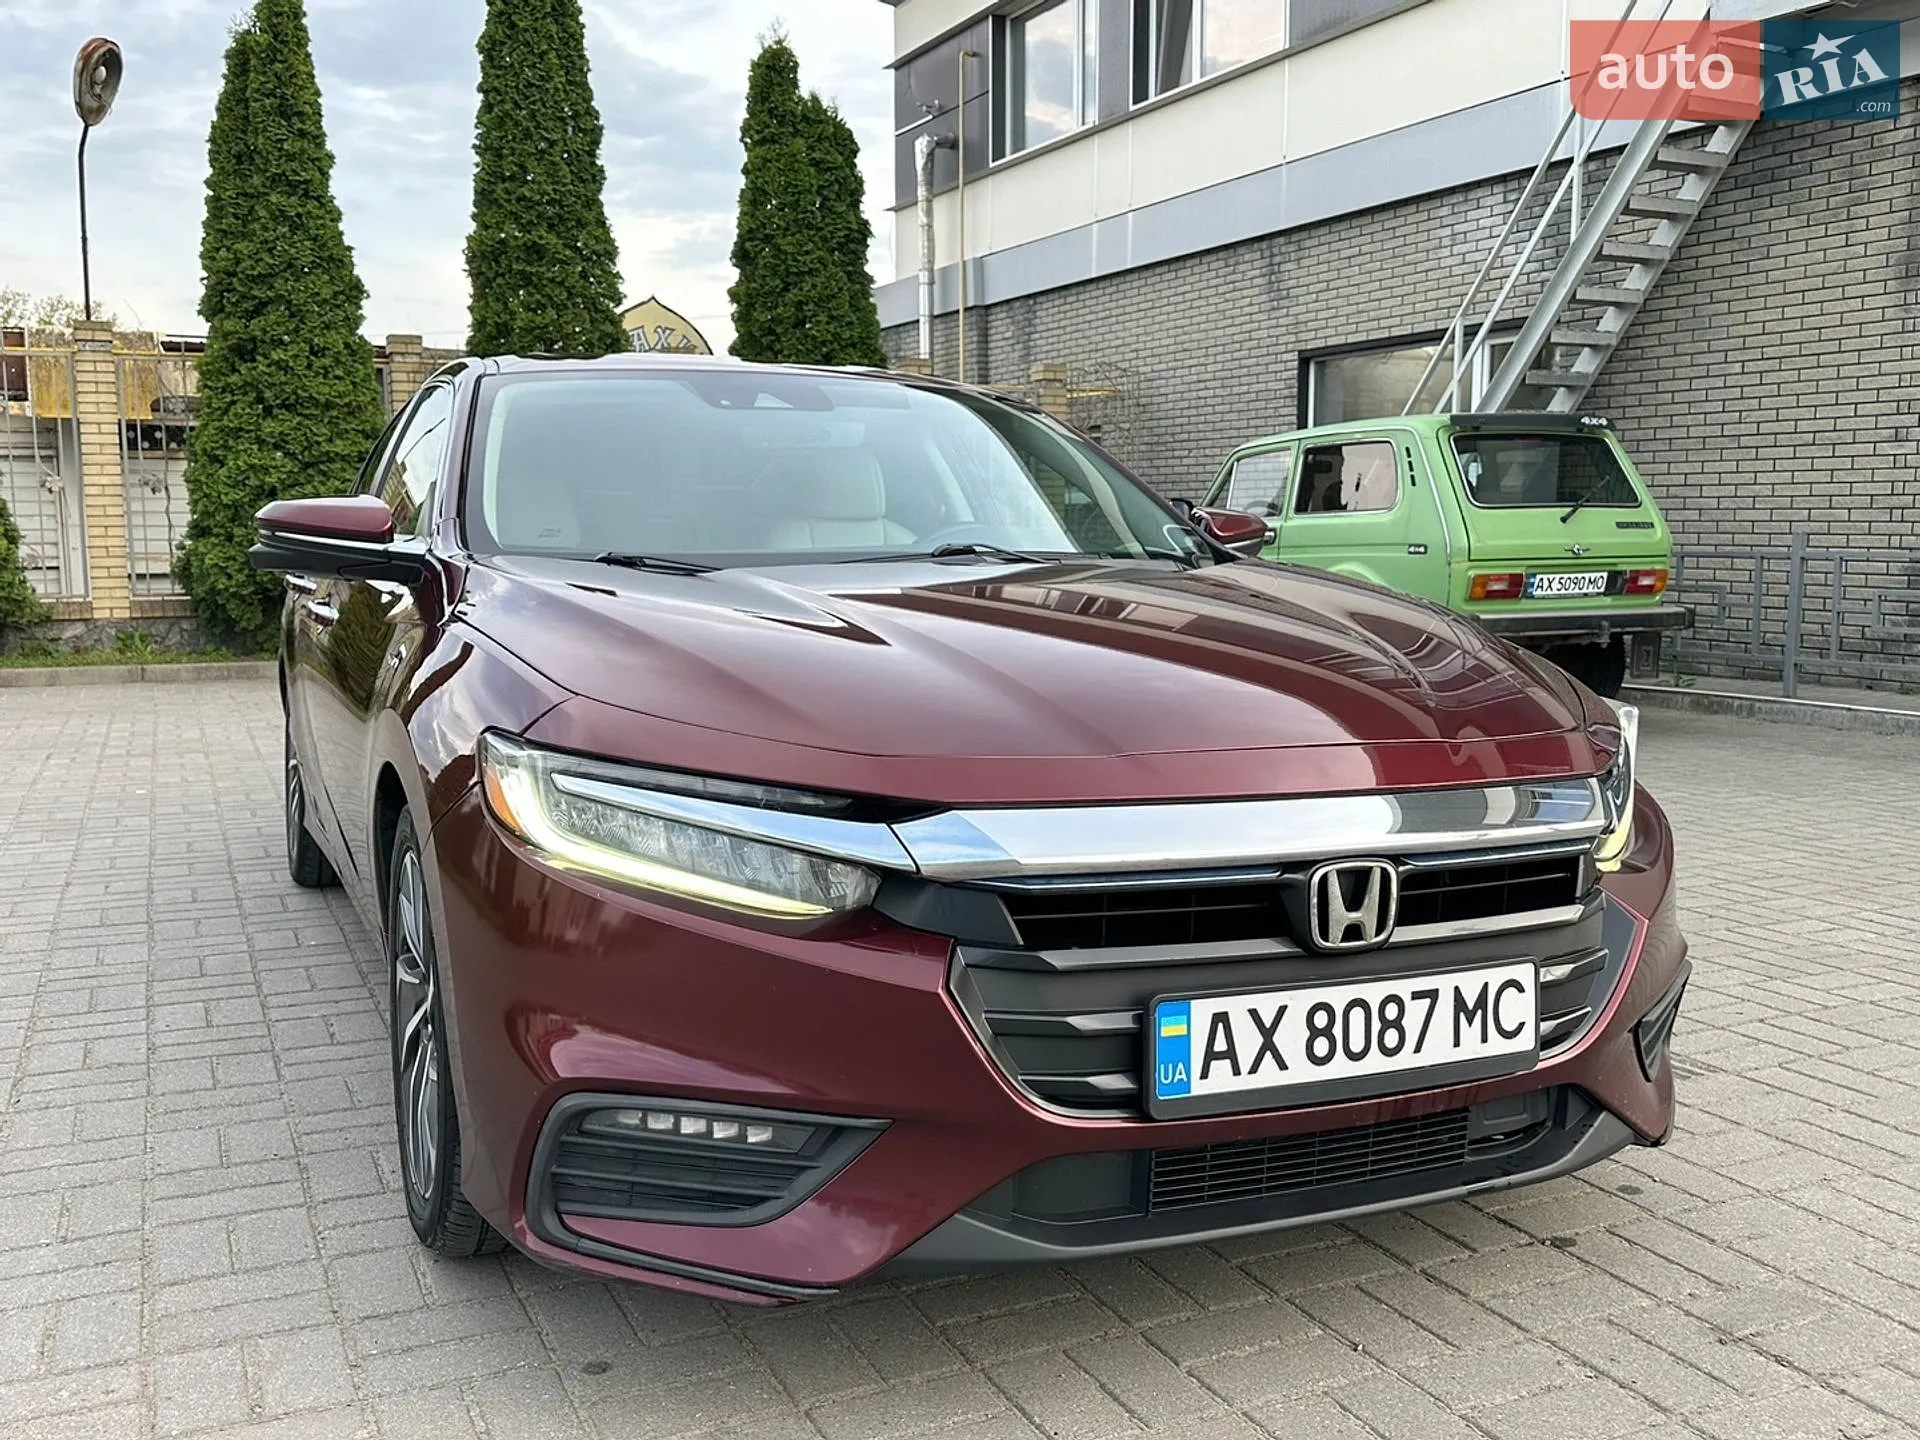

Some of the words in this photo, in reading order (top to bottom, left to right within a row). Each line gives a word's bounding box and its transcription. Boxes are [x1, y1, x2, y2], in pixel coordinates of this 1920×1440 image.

[1534, 576, 1556, 592] AX
[1556, 576, 1586, 592] 5090
[1586, 575, 1605, 591] MO
[1199, 1004, 1290, 1080] AX
[1305, 988, 1440, 1067] 8087
[1452, 978, 1526, 1048] MC
[1160, 1061, 1188, 1084] UA
